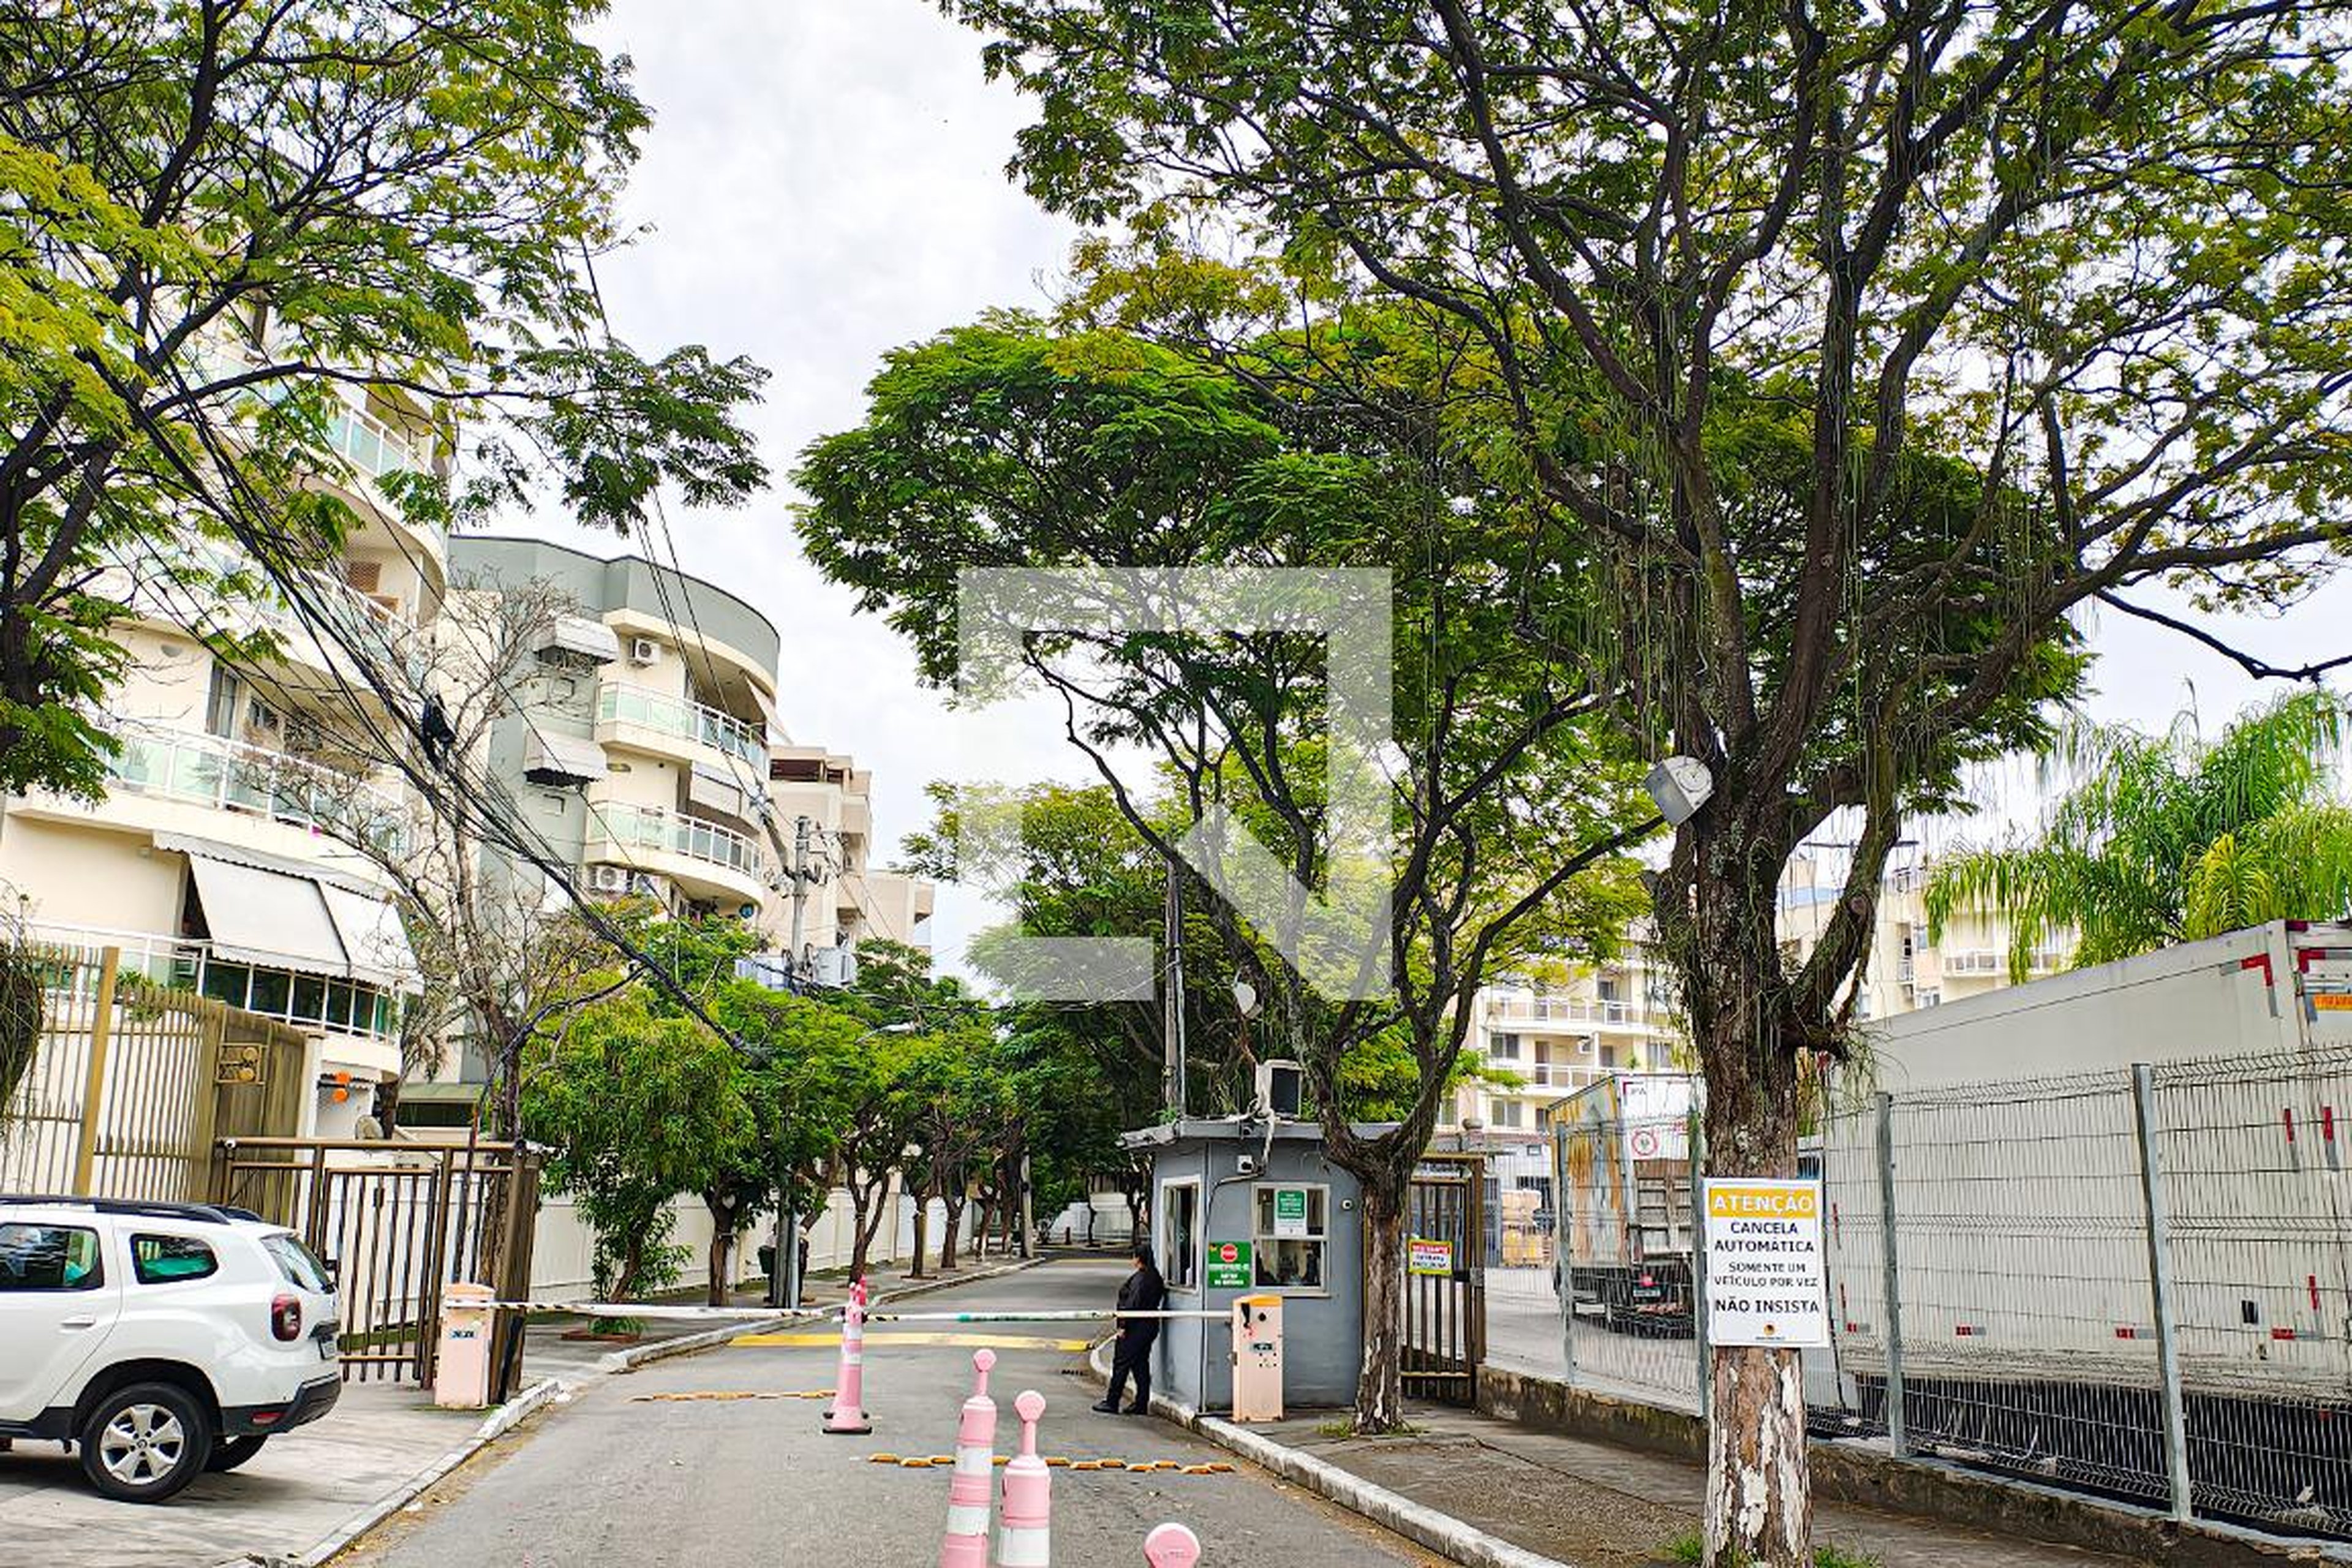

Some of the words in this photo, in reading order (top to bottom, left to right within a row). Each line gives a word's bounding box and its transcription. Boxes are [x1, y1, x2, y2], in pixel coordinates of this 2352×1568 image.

[1714, 1192, 1813, 1215] ATENÇÃO
[1730, 1221, 1798, 1234] CANCELA
[1714, 1237, 1814, 1252] AUTOMÁTICA
[1728, 1262, 1785, 1273] SOMENTE
[1788, 1263, 1806, 1273] UM
[1714, 1275, 1767, 1287] VEÍCULO
[1770, 1277, 1794, 1287] POR
[1796, 1277, 1819, 1287] VEZ
[1715, 1296, 1751, 1313] NÃO
[1755, 1299, 1820, 1314] INSISTA
